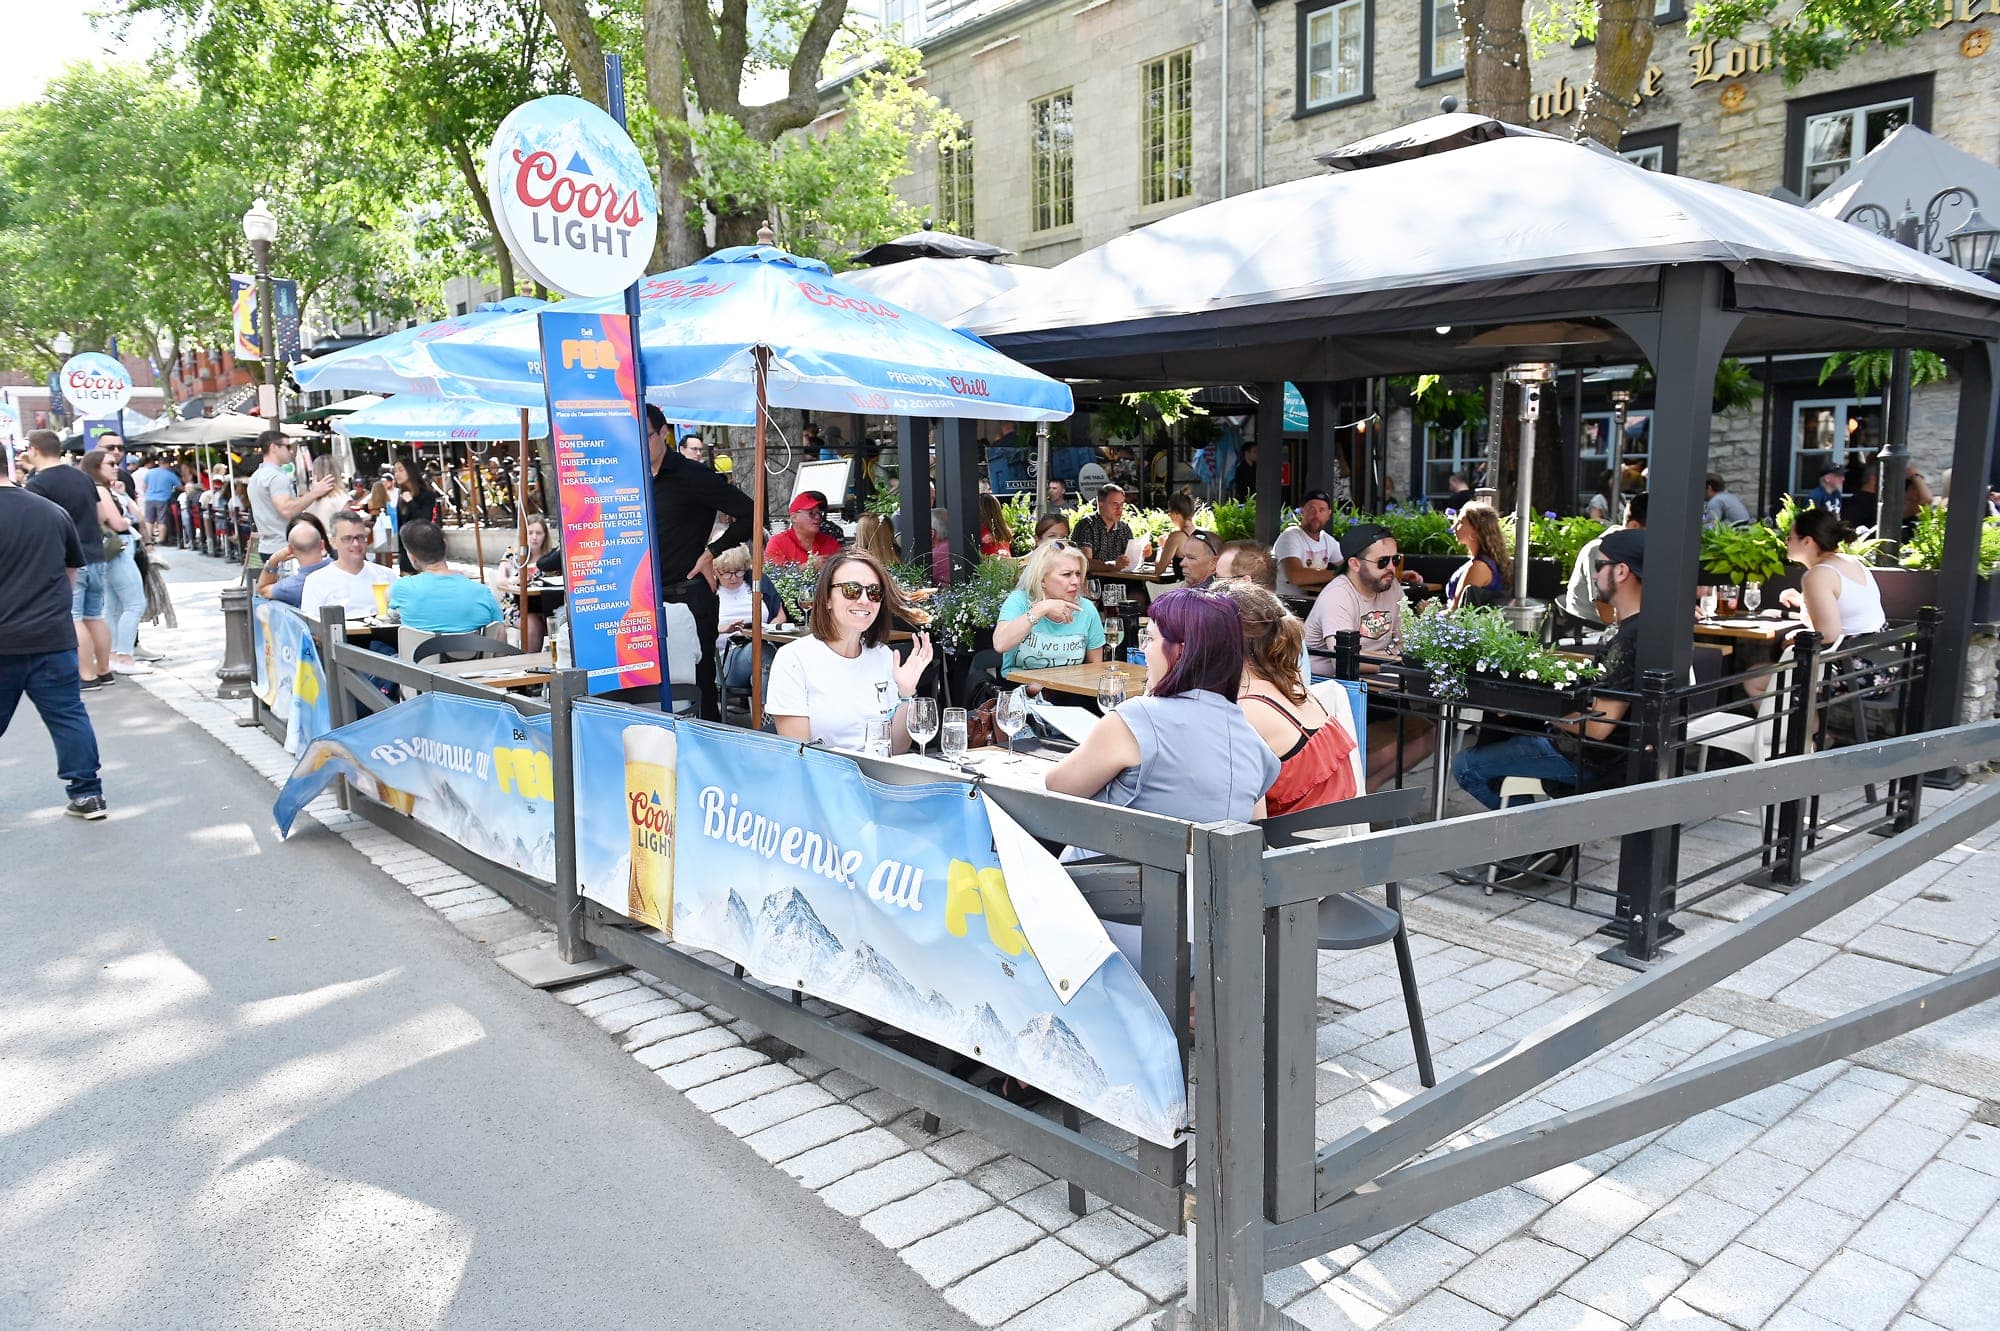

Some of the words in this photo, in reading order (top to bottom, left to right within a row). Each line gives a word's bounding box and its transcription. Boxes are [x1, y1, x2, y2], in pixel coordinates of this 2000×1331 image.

[512, 148, 644, 228] Coors
[532, 211, 632, 258] LIGHT
[787, 280, 900, 319] Coors
[67, 370, 125, 390] Coors
[946, 375, 990, 397] Chill
[76, 390, 119, 400] LIGHT
[450, 428, 480, 438] Chill
[576, 439, 605, 448] ENFANT
[561, 458, 590, 466] HUBERT
[590, 457, 619, 465] LENOIR
[563, 477, 580, 486] LISA
[580, 476, 614, 485] LEBLANC
[584, 495, 615, 505] ROBERT
[614, 494, 640, 502] FINLEY
[599, 512, 618, 520] FEMI
[618, 511, 636, 519] KUTI
[567, 522, 583, 531] THE
[583, 520, 617, 530] POSITIVE
[617, 518, 642, 527] FORCE
[579, 540, 600, 549] TIKEN
[600, 539, 616, 547] JAH
[616, 536, 644, 546] FAKOLY
[571, 561, 587, 570] THE
[586, 557, 622, 568] WEATHER
[572, 567, 603, 577] STATION
[573, 585, 595, 595] GROS
[595, 581, 617, 592] MENÉ
[575, 600, 631, 613] DAKHABRAKHA
[594, 620, 620, 631] URBAN
[619, 616, 652, 627] SCIENCE
[607, 627, 632, 637] BRASS
[631, 624, 652, 633] BAND
[627, 640, 654, 651] PONGO
[1041, 642, 1059, 652] we
[370, 736, 473, 774] Bienvenue
[628, 791, 674, 839] Coors
[637, 827, 672, 859] LIGHT
[698, 785, 863, 890] Bienvenue
[867, 858, 924, 912] au
[945, 857, 1034, 958] FE
